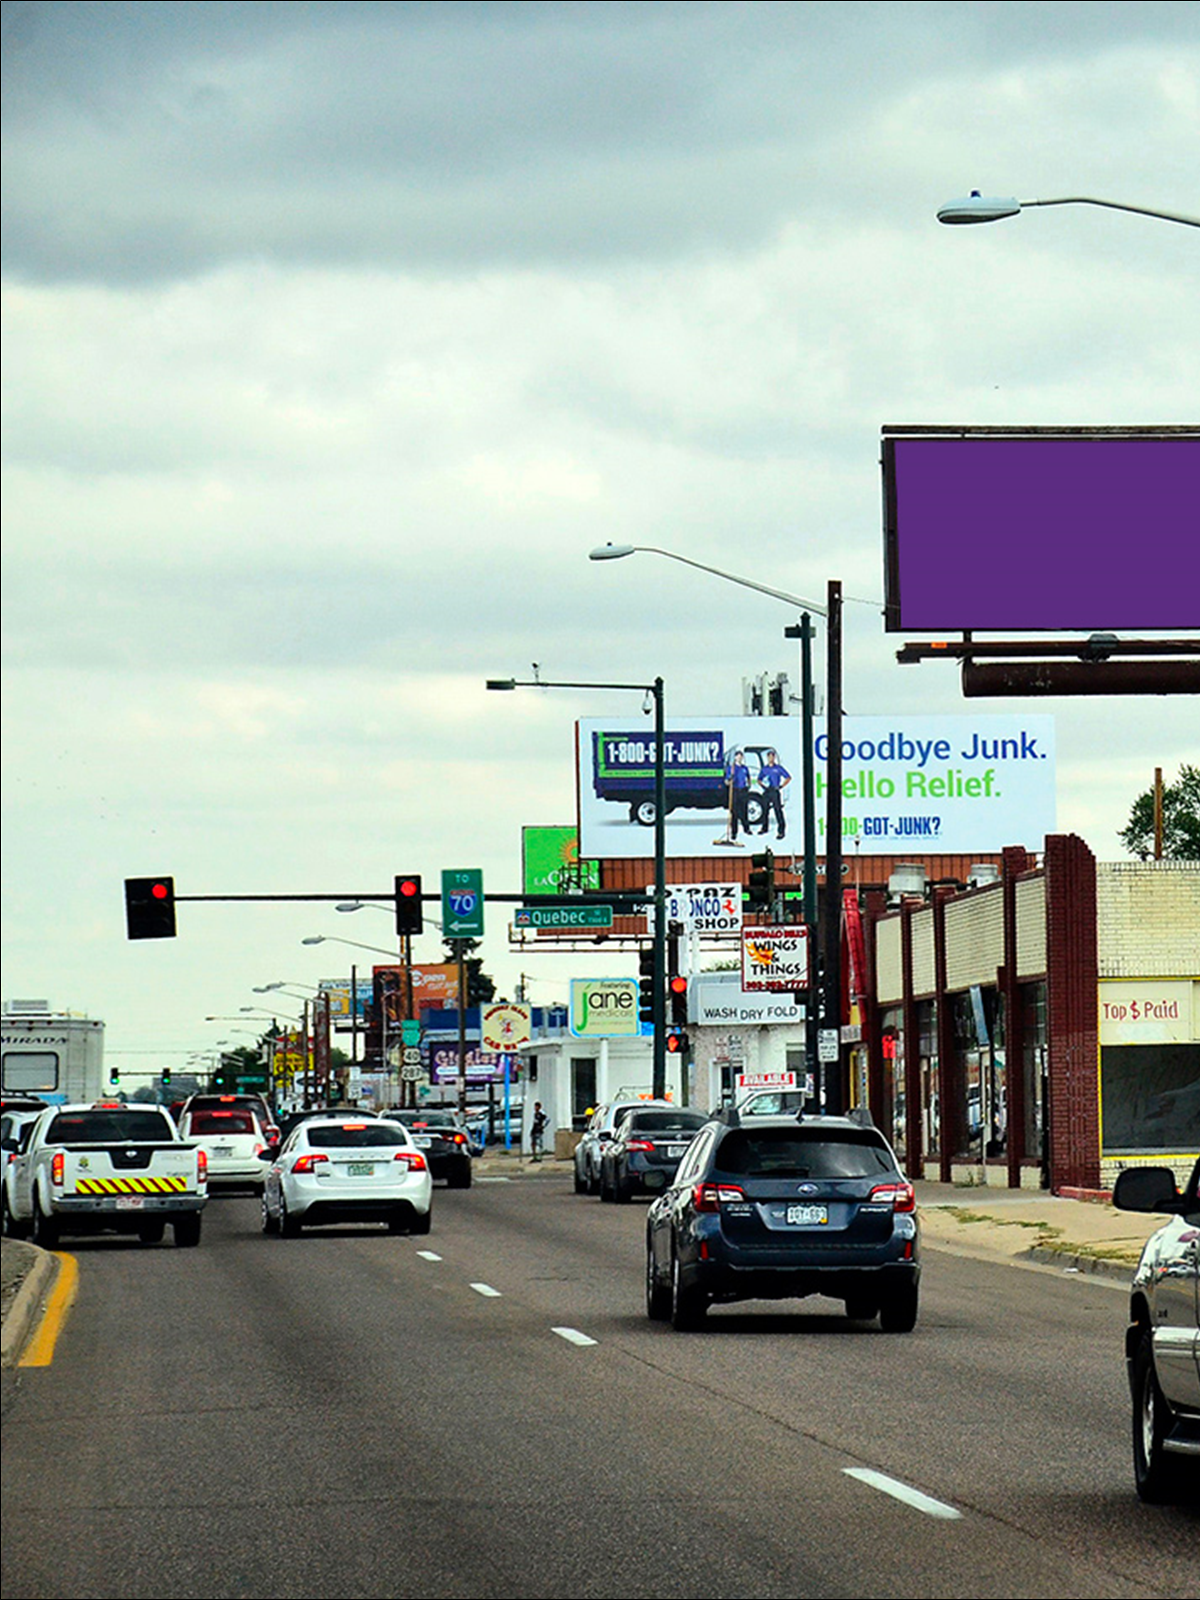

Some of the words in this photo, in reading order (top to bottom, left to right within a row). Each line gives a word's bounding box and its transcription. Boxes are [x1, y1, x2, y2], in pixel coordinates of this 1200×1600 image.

[607, 741, 720, 763] 1-800-GT-JUNK?
[961, 731, 1047, 760] Junk.
[906, 768, 1002, 798] Relief.
[817, 816, 941, 836] 1-00-GOT-JUNK?
[455, 874, 469, 883] TO
[450, 895, 474, 911] 70
[670, 898, 721, 917] BONCO
[531, 910, 586, 925] Quebec
[694, 917, 739, 930] SHOP
[753, 939, 798, 951] WINGS
[771, 952, 780, 963] &
[750, 963, 801, 976] THINGS
[576, 983, 633, 1031] jane
[703, 1008, 738, 1019] WASH
[740, 1009, 765, 1020] DRY
[767, 1006, 798, 1017] FOLD
[1102, 1002, 1127, 1020] Top
[1130, 1000, 1140, 1020] $
[1143, 1001, 1178, 1019] Paid
[1, 1036, 69, 1045] MIRADA
[404, 1050, 419, 1061] 40
[402, 1068, 421, 1078] 287
